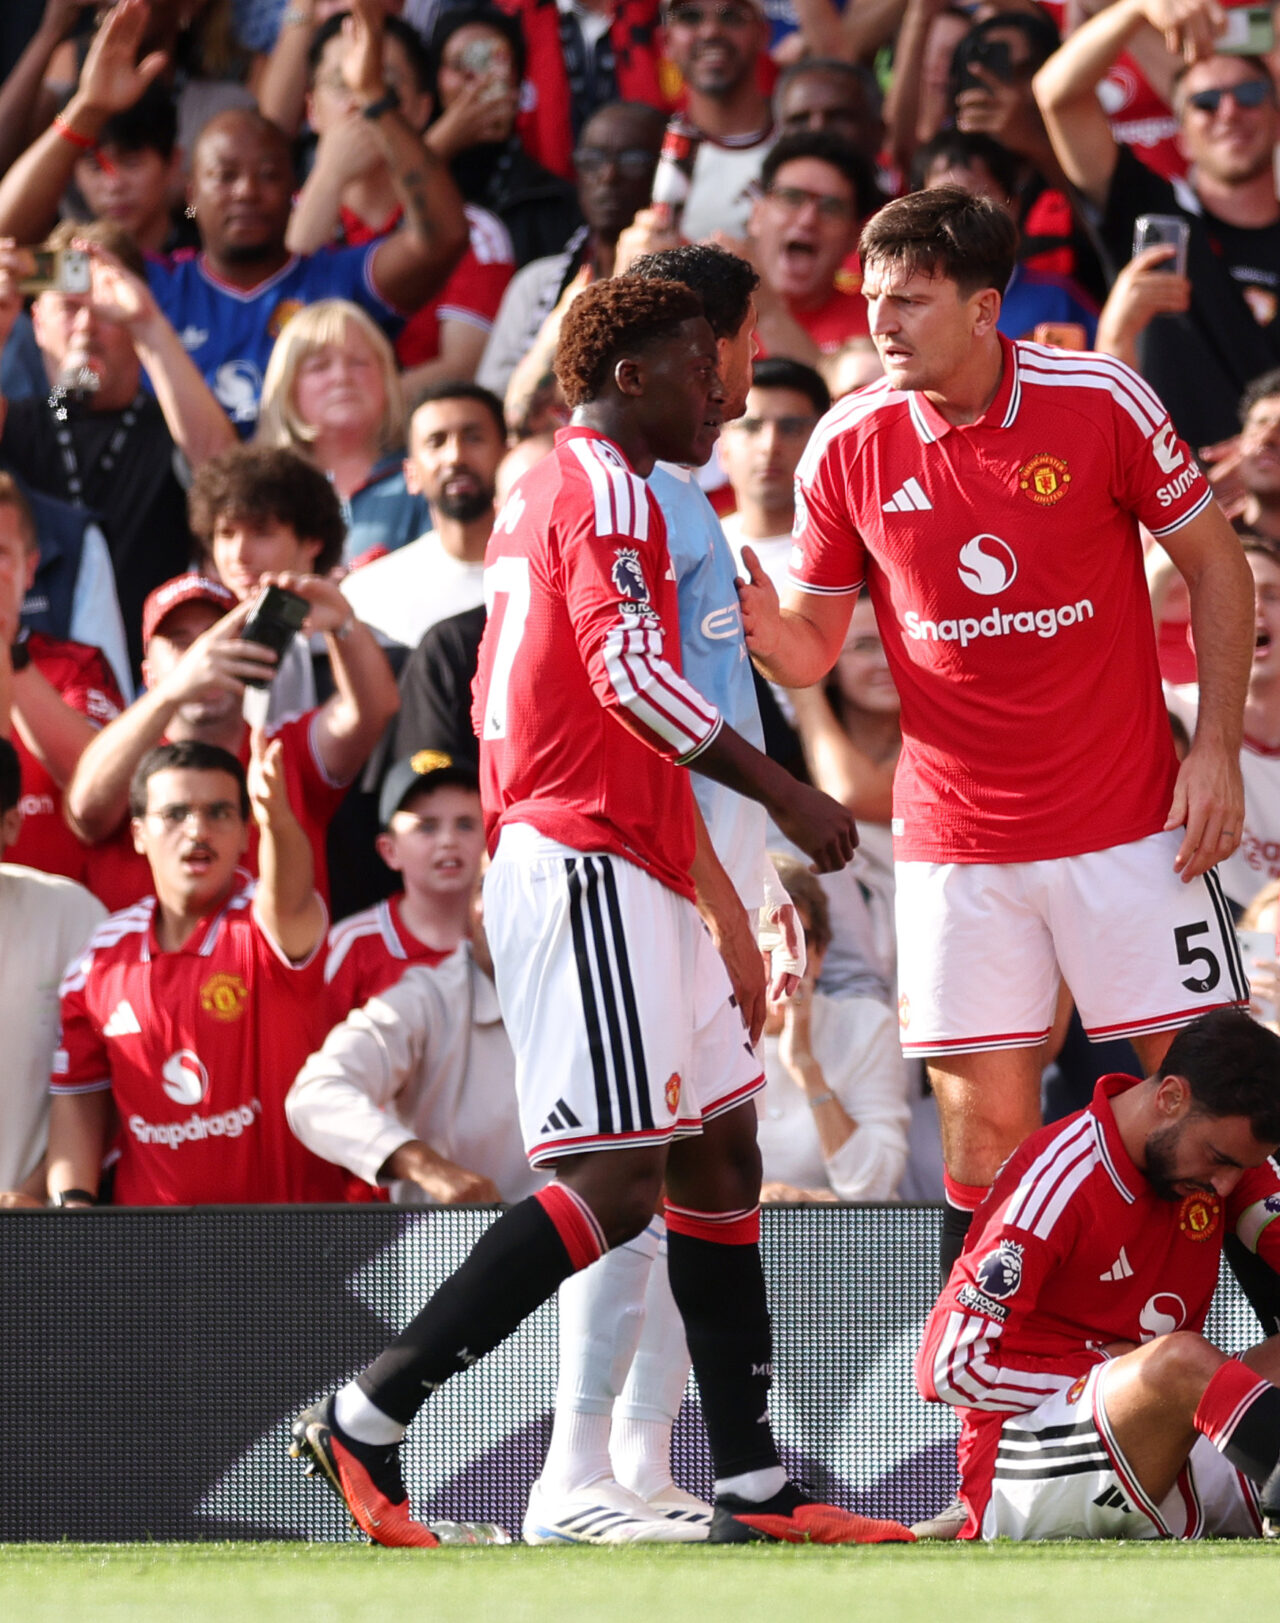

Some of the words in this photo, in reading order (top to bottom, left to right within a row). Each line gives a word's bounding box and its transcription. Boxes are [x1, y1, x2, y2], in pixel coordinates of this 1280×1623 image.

[1156, 461, 1203, 507] sumu
[904, 599, 1095, 648] Snapdragon
[1174, 920, 1220, 993] 5
